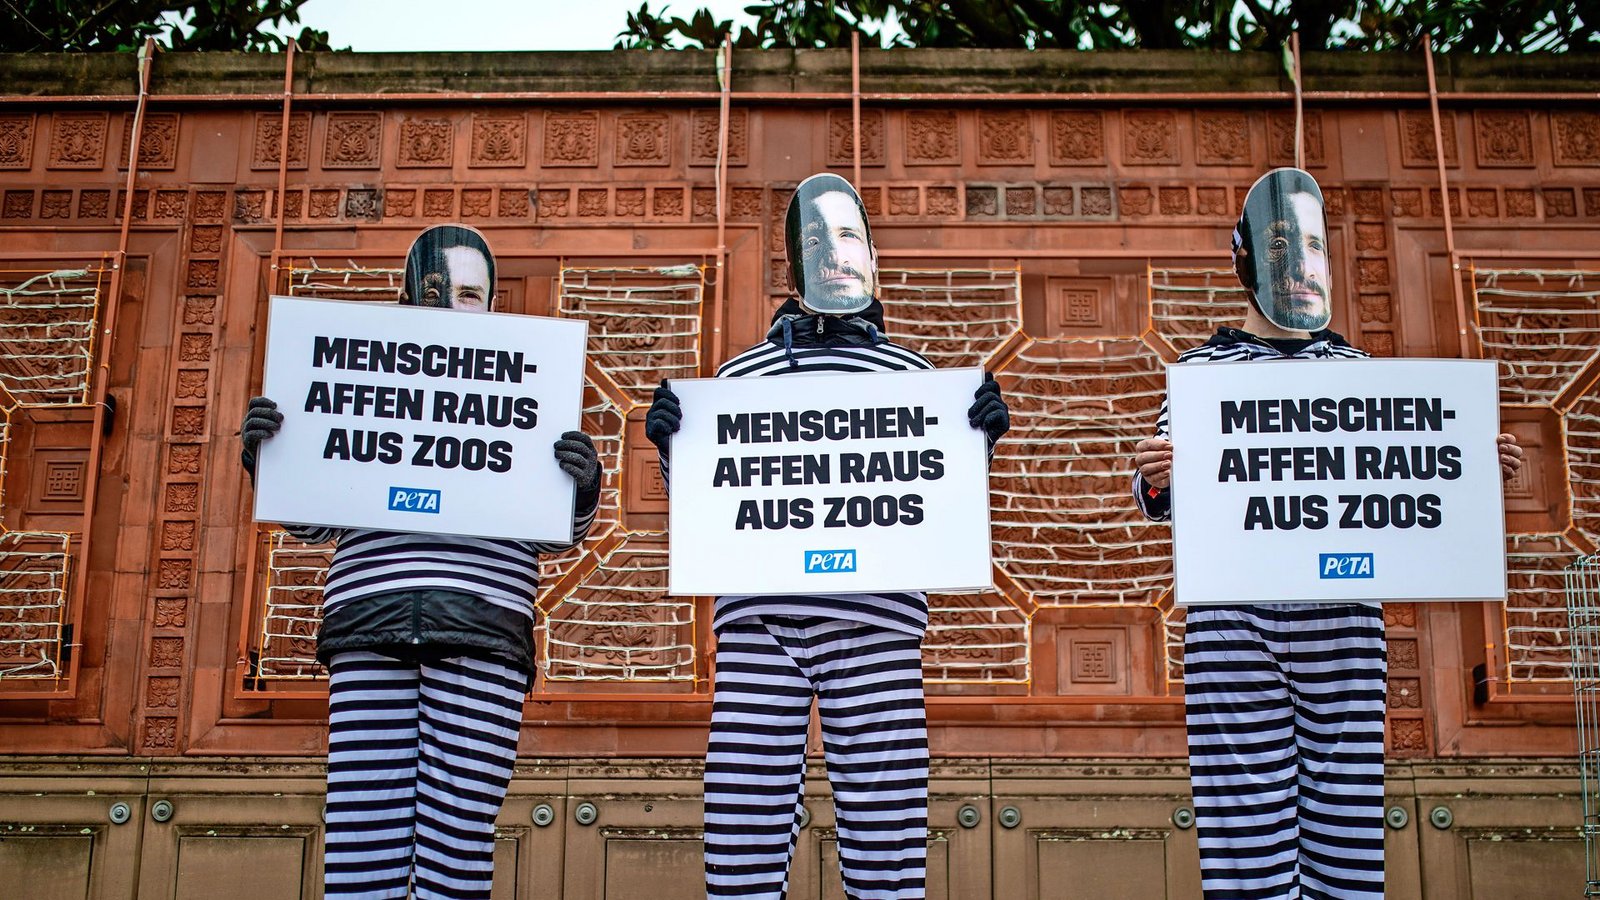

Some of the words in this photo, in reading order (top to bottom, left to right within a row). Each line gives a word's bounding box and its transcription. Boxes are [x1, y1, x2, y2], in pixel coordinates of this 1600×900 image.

[312, 335, 538, 384] MENSCHEN-
[304, 380, 425, 421] AFFEN
[432, 390, 539, 430] RAUS
[1220, 397, 1456, 435] MENSCHEN-
[717, 406, 939, 445] MENSCHEN-
[322, 427, 404, 465] AUS
[411, 434, 513, 473] ZOOS
[712, 453, 831, 488] AFFEN
[839, 448, 945, 484] RAUS
[1218, 446, 1346, 483] AFFEN
[1354, 445, 1462, 481] RAUS
[735, 497, 814, 531] AUS
[823, 493, 924, 528] ZOOS
[1243, 494, 1329, 531] AUS
[1338, 493, 1442, 530] ZOOS
